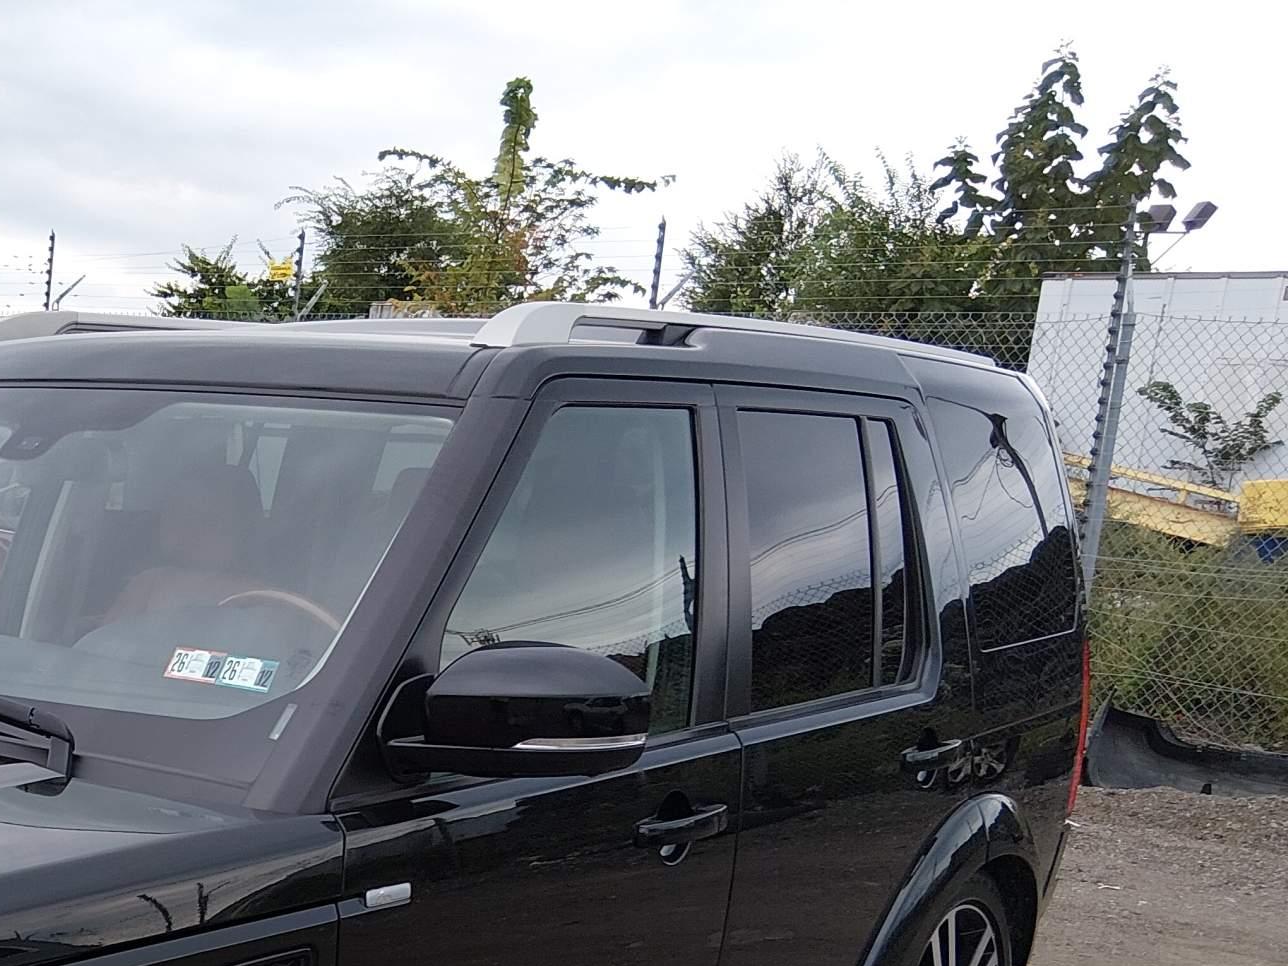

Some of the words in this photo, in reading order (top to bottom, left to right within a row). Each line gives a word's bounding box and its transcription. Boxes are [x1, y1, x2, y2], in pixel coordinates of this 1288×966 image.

[170, 652, 189, 673] 26
[203, 660, 221, 679] 12
[222, 659, 240, 681] 26
